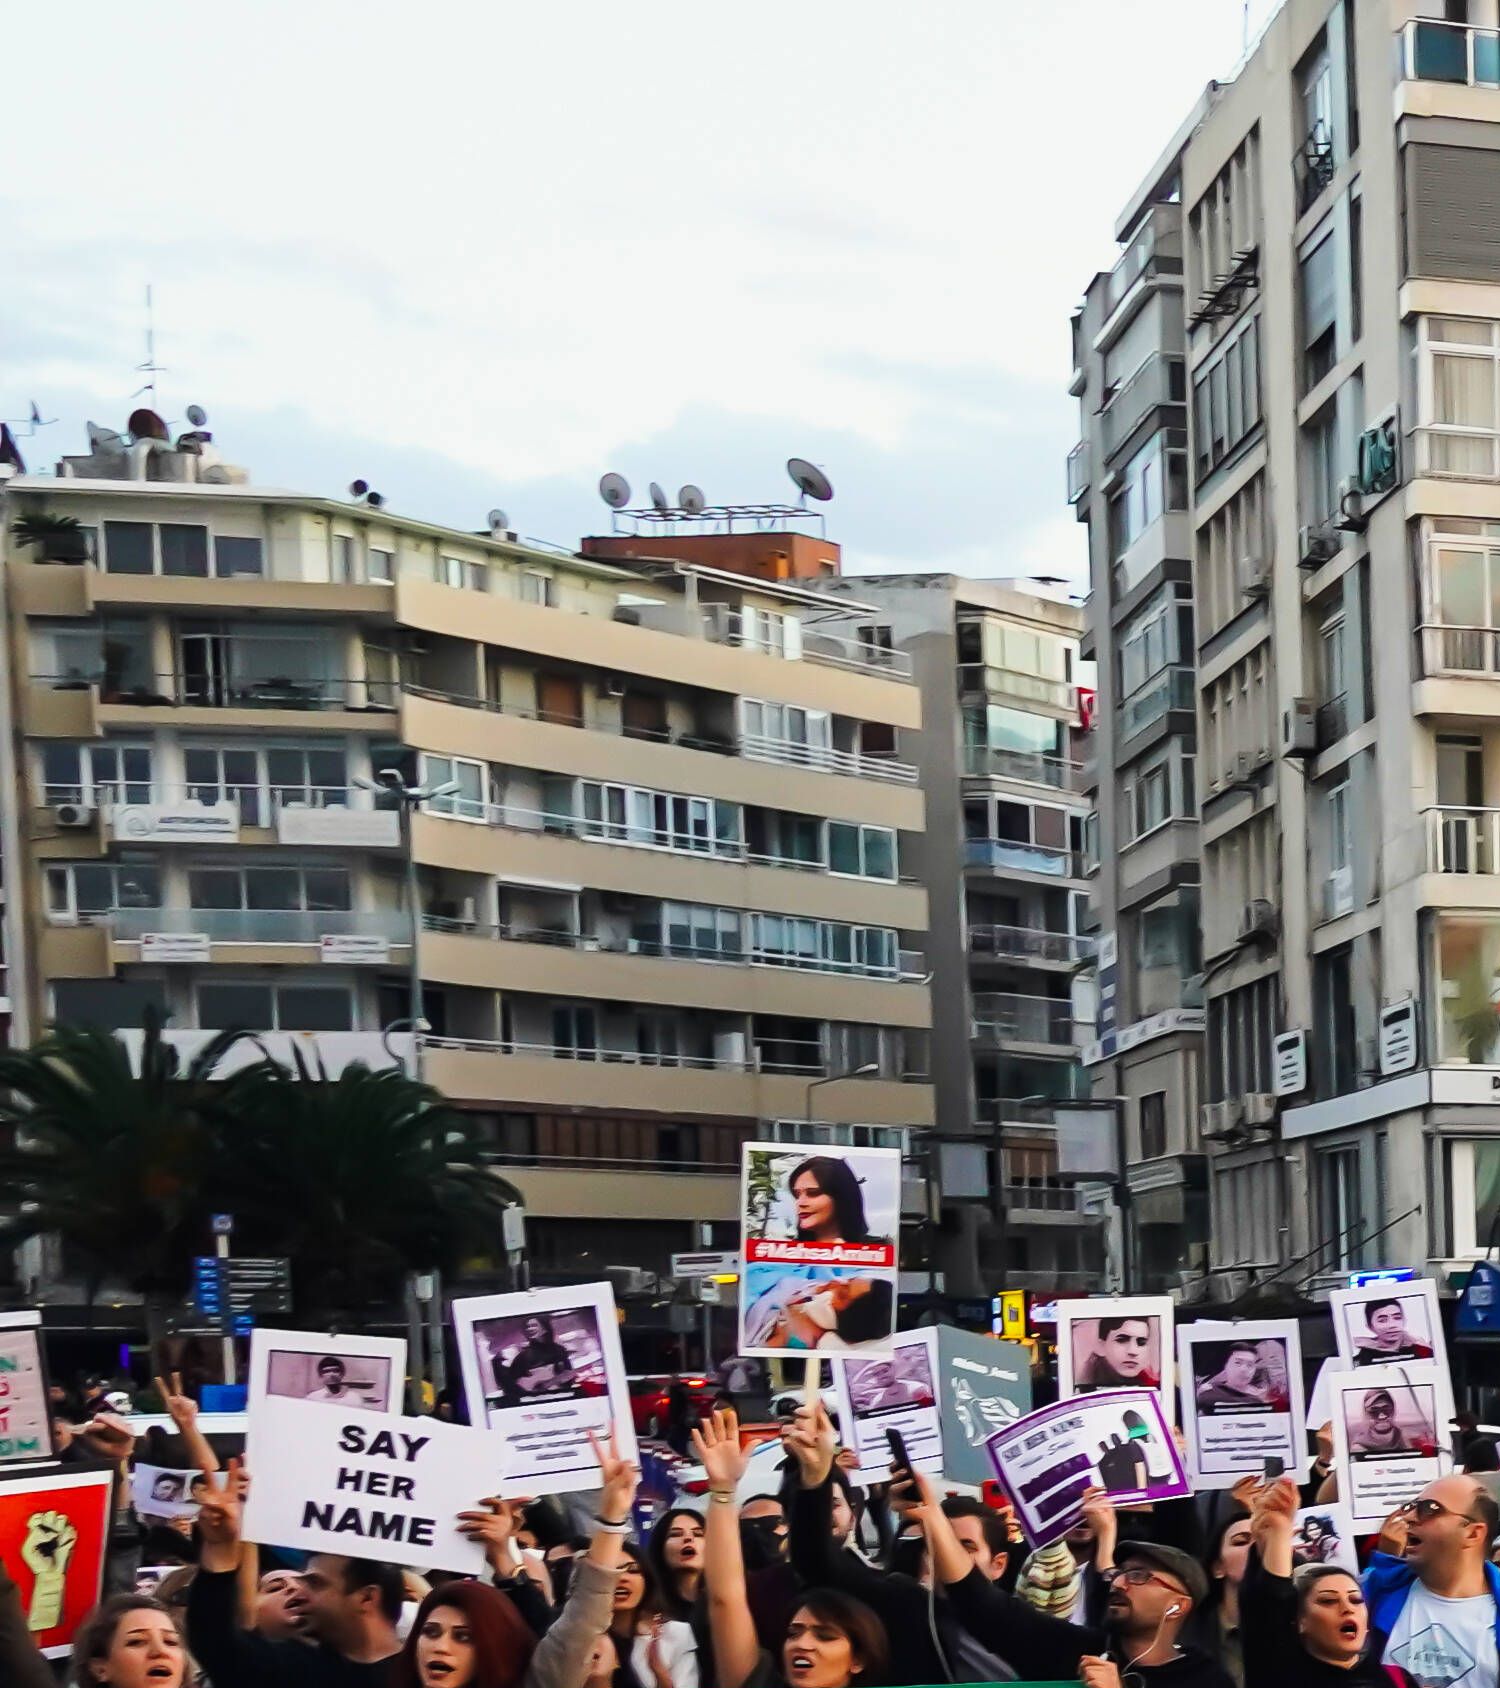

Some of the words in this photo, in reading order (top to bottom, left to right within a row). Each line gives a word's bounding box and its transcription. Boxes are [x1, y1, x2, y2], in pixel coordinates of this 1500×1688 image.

[337, 1425, 432, 1462] SAY
[336, 1467, 415, 1500] HER
[302, 1501, 437, 1546] NAME
